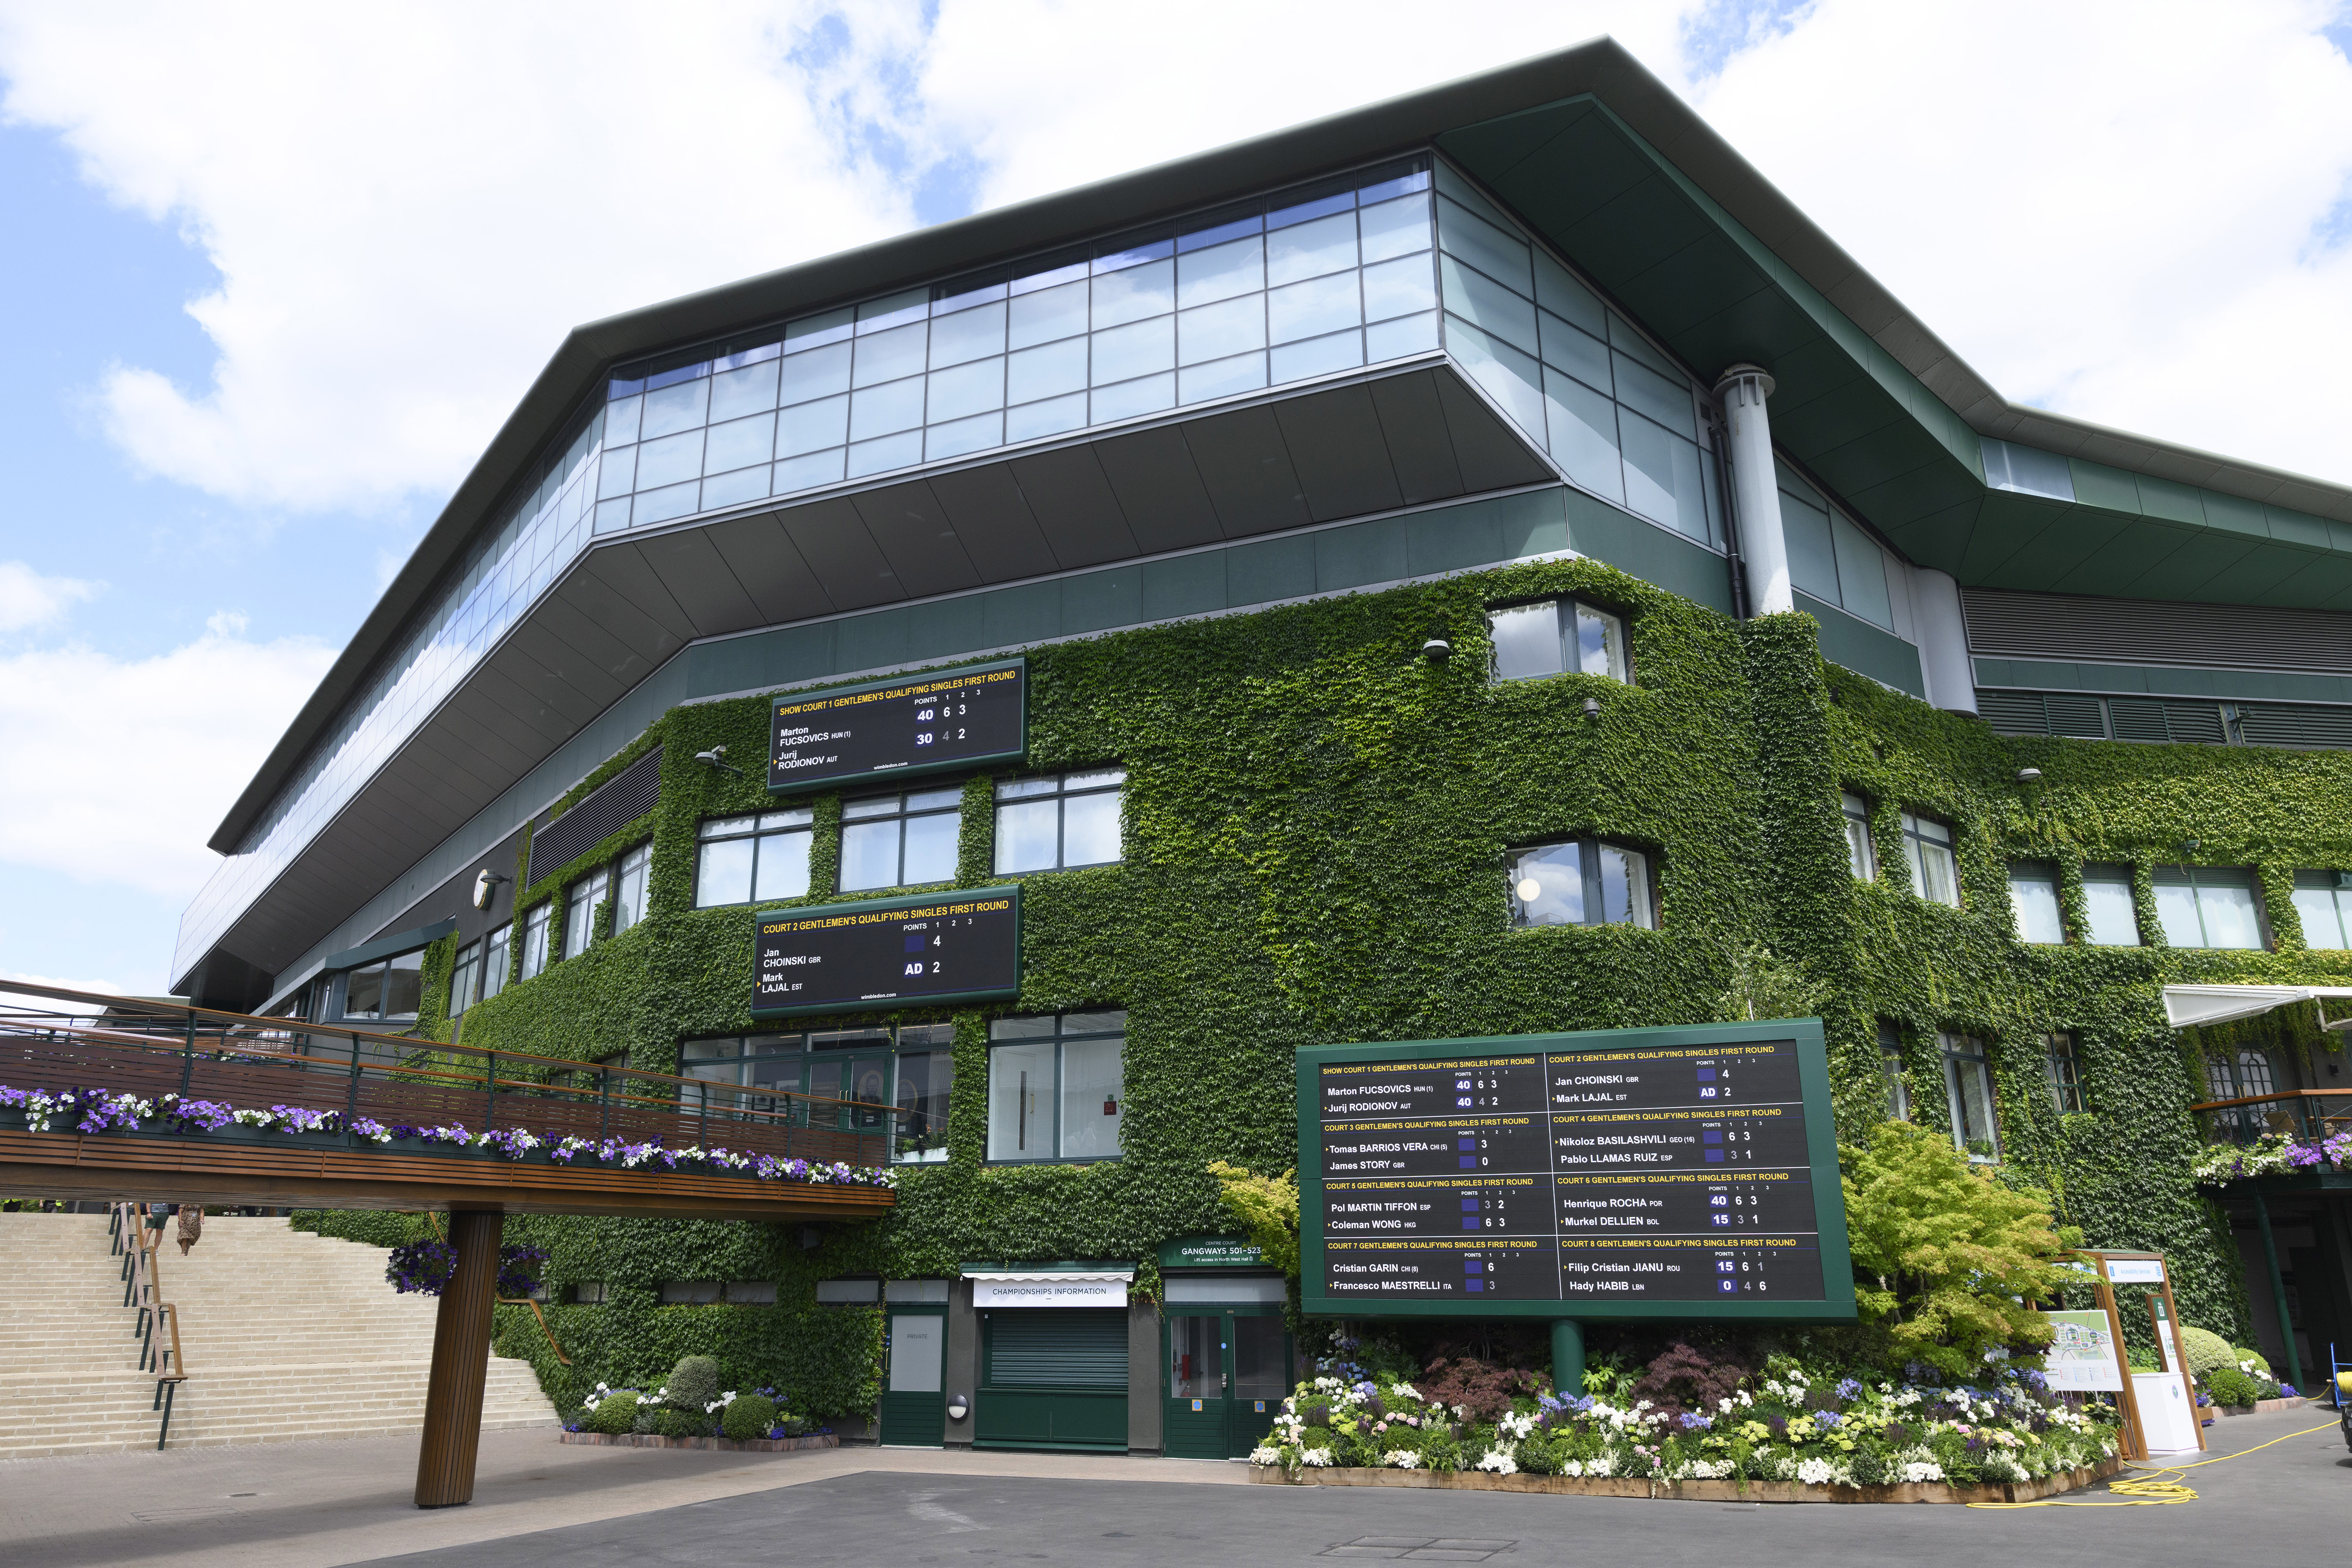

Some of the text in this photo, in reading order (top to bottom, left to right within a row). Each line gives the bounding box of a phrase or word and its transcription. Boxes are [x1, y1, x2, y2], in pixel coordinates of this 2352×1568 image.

[780, 705, 801, 716] SHOW
[802, 701, 828, 712] COURT
[834, 692, 884, 707] GENTLEMEN'S
[885, 685, 929, 699] QUALIFYING
[930, 679, 963, 692] SINGLES
[965, 675, 987, 686] FIRST
[988, 670, 1015, 683] ROUND
[914, 696, 937, 705] POINTS
[917, 704, 966, 721] 40 6 3
[781, 727, 809, 737] Marton
[916, 728, 965, 745] 30 4 2
[780, 732, 829, 747] FUCSOVICS
[778, 750, 797, 760] Jurij
[778, 756, 825, 770] RODIONOV
[873, 762, 908, 770] wimbledon.com
[764, 900, 1009, 934] COURT 2 GENTLEMEN'S QUALIFYING SINGLES FIRST ROUND
[903, 923, 927, 931] POINTS
[933, 935, 941, 946] 4
[764, 949, 779, 957] Jan
[764, 956, 806, 968] CHOINSKI
[905, 961, 940, 975] AD 2
[763, 973, 783, 983] Mark
[762, 983, 790, 993] LAJAL
[1372, 1064, 1417, 1072] GENTLEMEN'S
[1418, 1061, 1458, 1070] QUALIFYING
[1456, 1079, 1497, 1089] 40 6 3
[1555, 1077, 1572, 1086] Jan
[1575, 1075, 1623, 1085] CHOINSKI
[1328, 1088, 1357, 1096] Marton
[1359, 1084, 1411, 1095] FUCSOVICS
[1457, 1097, 1498, 1106] 40 4 2
[1556, 1094, 1580, 1103] Mark
[1582, 1092, 1613, 1102] LAJAL
[1328, 1103, 1347, 1114] Jurij
[1349, 1101, 1398, 1112] RODIONOV
[1587, 1113, 1641, 1122] GENTLEMEN'S
[1642, 1112, 1689, 1120] QUALIFYING
[1559, 1137, 1595, 1146] Nikoloz
[1597, 1135, 1666, 1145] BASILASHVILI
[1329, 1145, 1358, 1153] Tomas
[1359, 1143, 1401, 1152] BARRIOS
[1402, 1142, 1428, 1151] VERA
[1561, 1155, 1588, 1163] Pablo
[1590, 1153, 1631, 1163] LLAMAS
[1633, 1153, 1658, 1162] RUIZ
[1330, 1162, 1358, 1170] James
[1360, 1160, 1390, 1169] STORY
[1564, 1199, 1607, 1210] Henrique
[1609, 1198, 1647, 1207] ROCHA
[1711, 1196, 1757, 1205] 40 6 3
[1331, 1203, 1345, 1212] Pol
[1347, 1203, 1382, 1212] MARTIN
[1384, 1202, 1417, 1211] TIFFON
[1331, 1220, 1370, 1229] Coleman
[1371, 1220, 1401, 1228] WONG
[1565, 1217, 1598, 1226] Murkel
[1600, 1216, 1644, 1226] DELLIEN
[1333, 1264, 1367, 1272] Cristian
[1369, 1264, 1399, 1272] GARIN
[1568, 1263, 1589, 1274] Filip
[1592, 1263, 1630, 1272] Cristian
[1632, 1263, 1663, 1272] JIANU
[1334, 1281, 1379, 1290] Francesco
[1382, 1281, 1440, 1290] MAESTRELLI
[1570, 1281, 1594, 1292] Hady
[1597, 1281, 1629, 1290] HABIB
